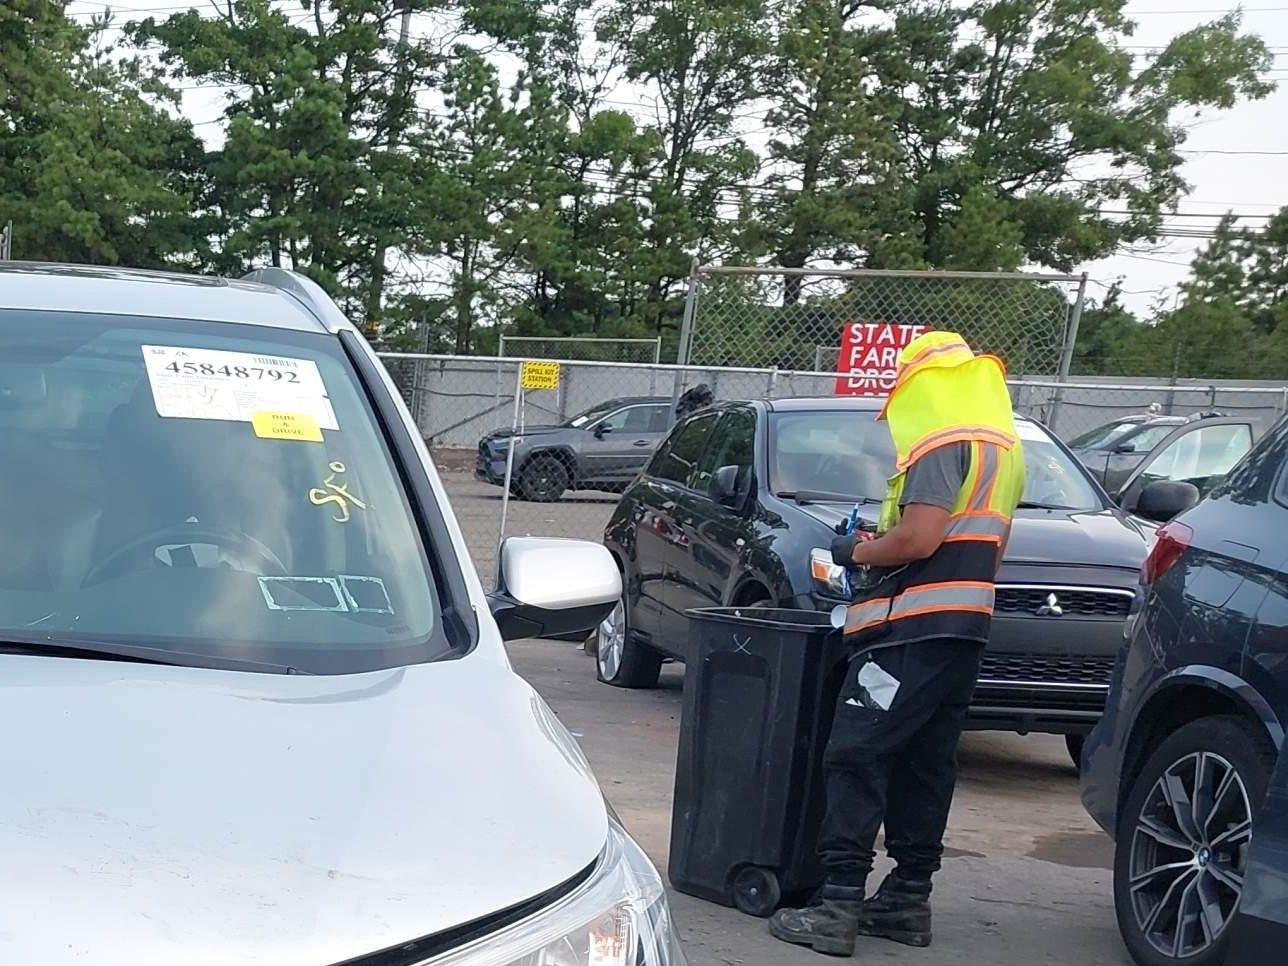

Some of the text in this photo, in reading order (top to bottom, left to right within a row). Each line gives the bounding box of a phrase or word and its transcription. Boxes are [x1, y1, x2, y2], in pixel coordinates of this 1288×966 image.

[849, 323, 925, 345] STATE
[849, 346, 902, 368] FAR
[165, 361, 301, 384] 45848792
[527, 368, 544, 376] SPILL
[527, 375, 553, 383] STATION
